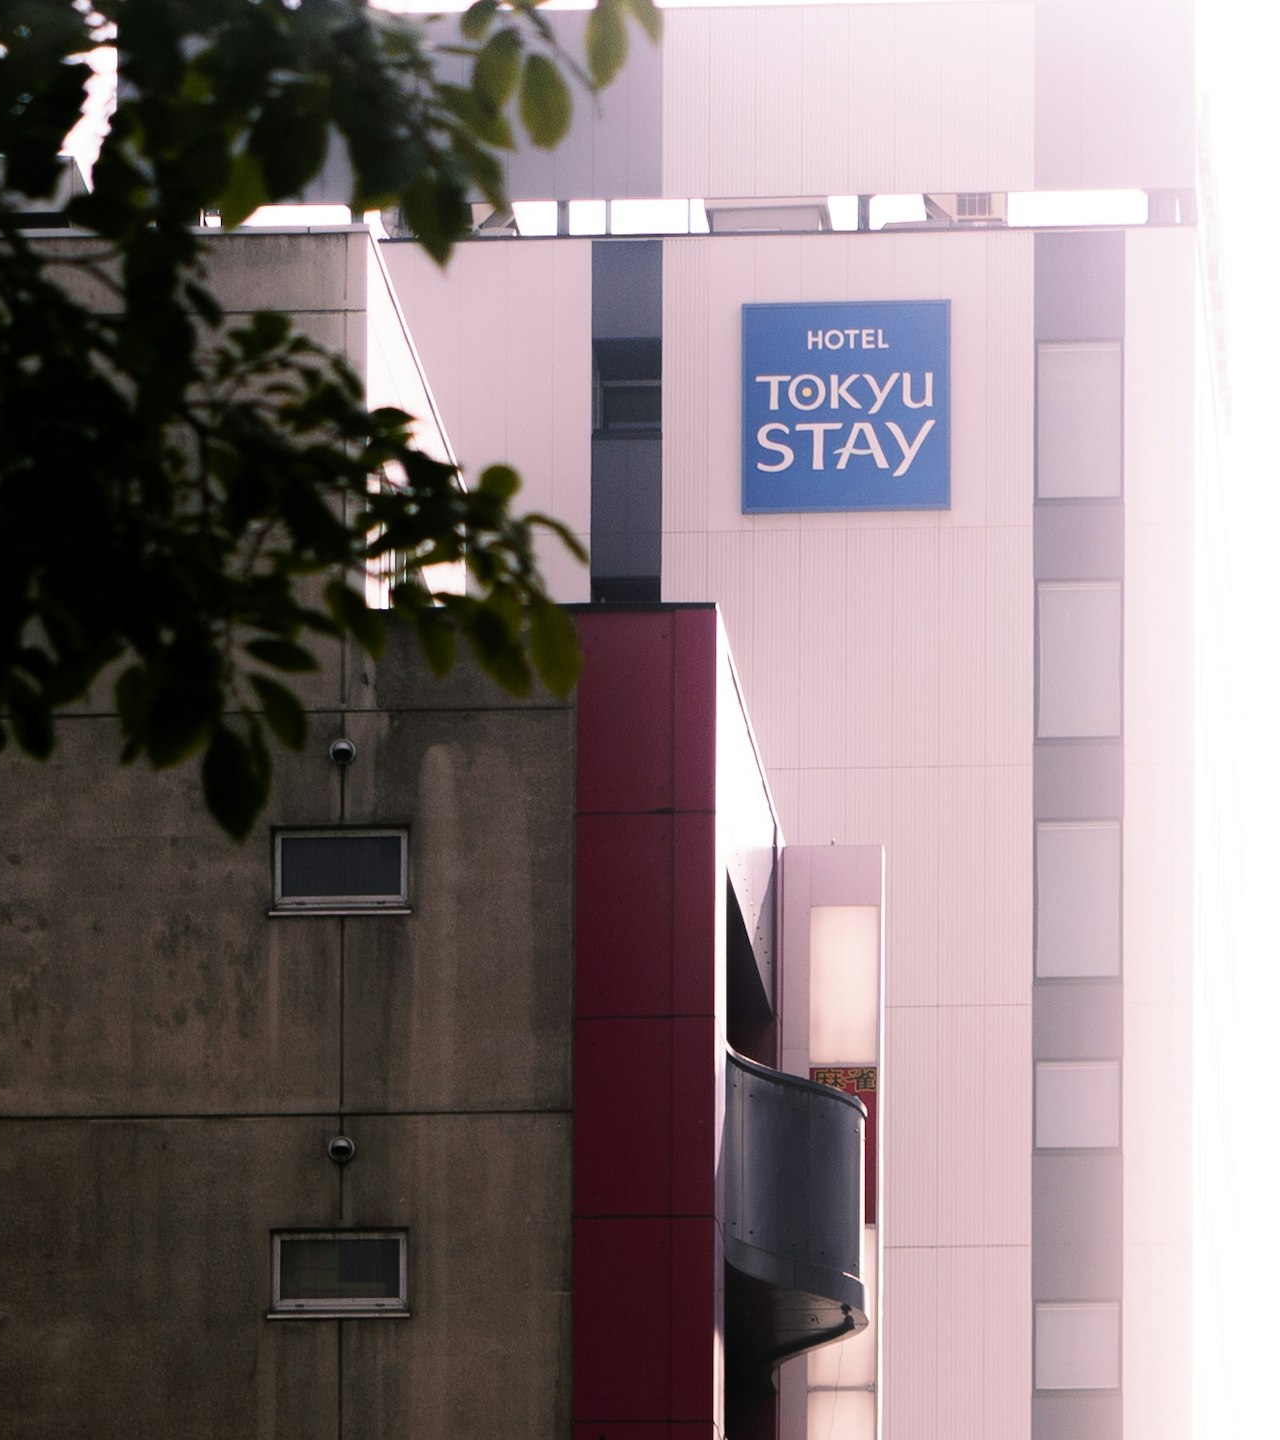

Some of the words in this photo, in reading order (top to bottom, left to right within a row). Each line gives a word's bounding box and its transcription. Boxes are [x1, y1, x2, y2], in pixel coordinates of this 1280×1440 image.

[806, 328, 890, 350] HOTEL
[754, 371, 934, 414] TOKYU
[755, 419, 937, 478] STAY
